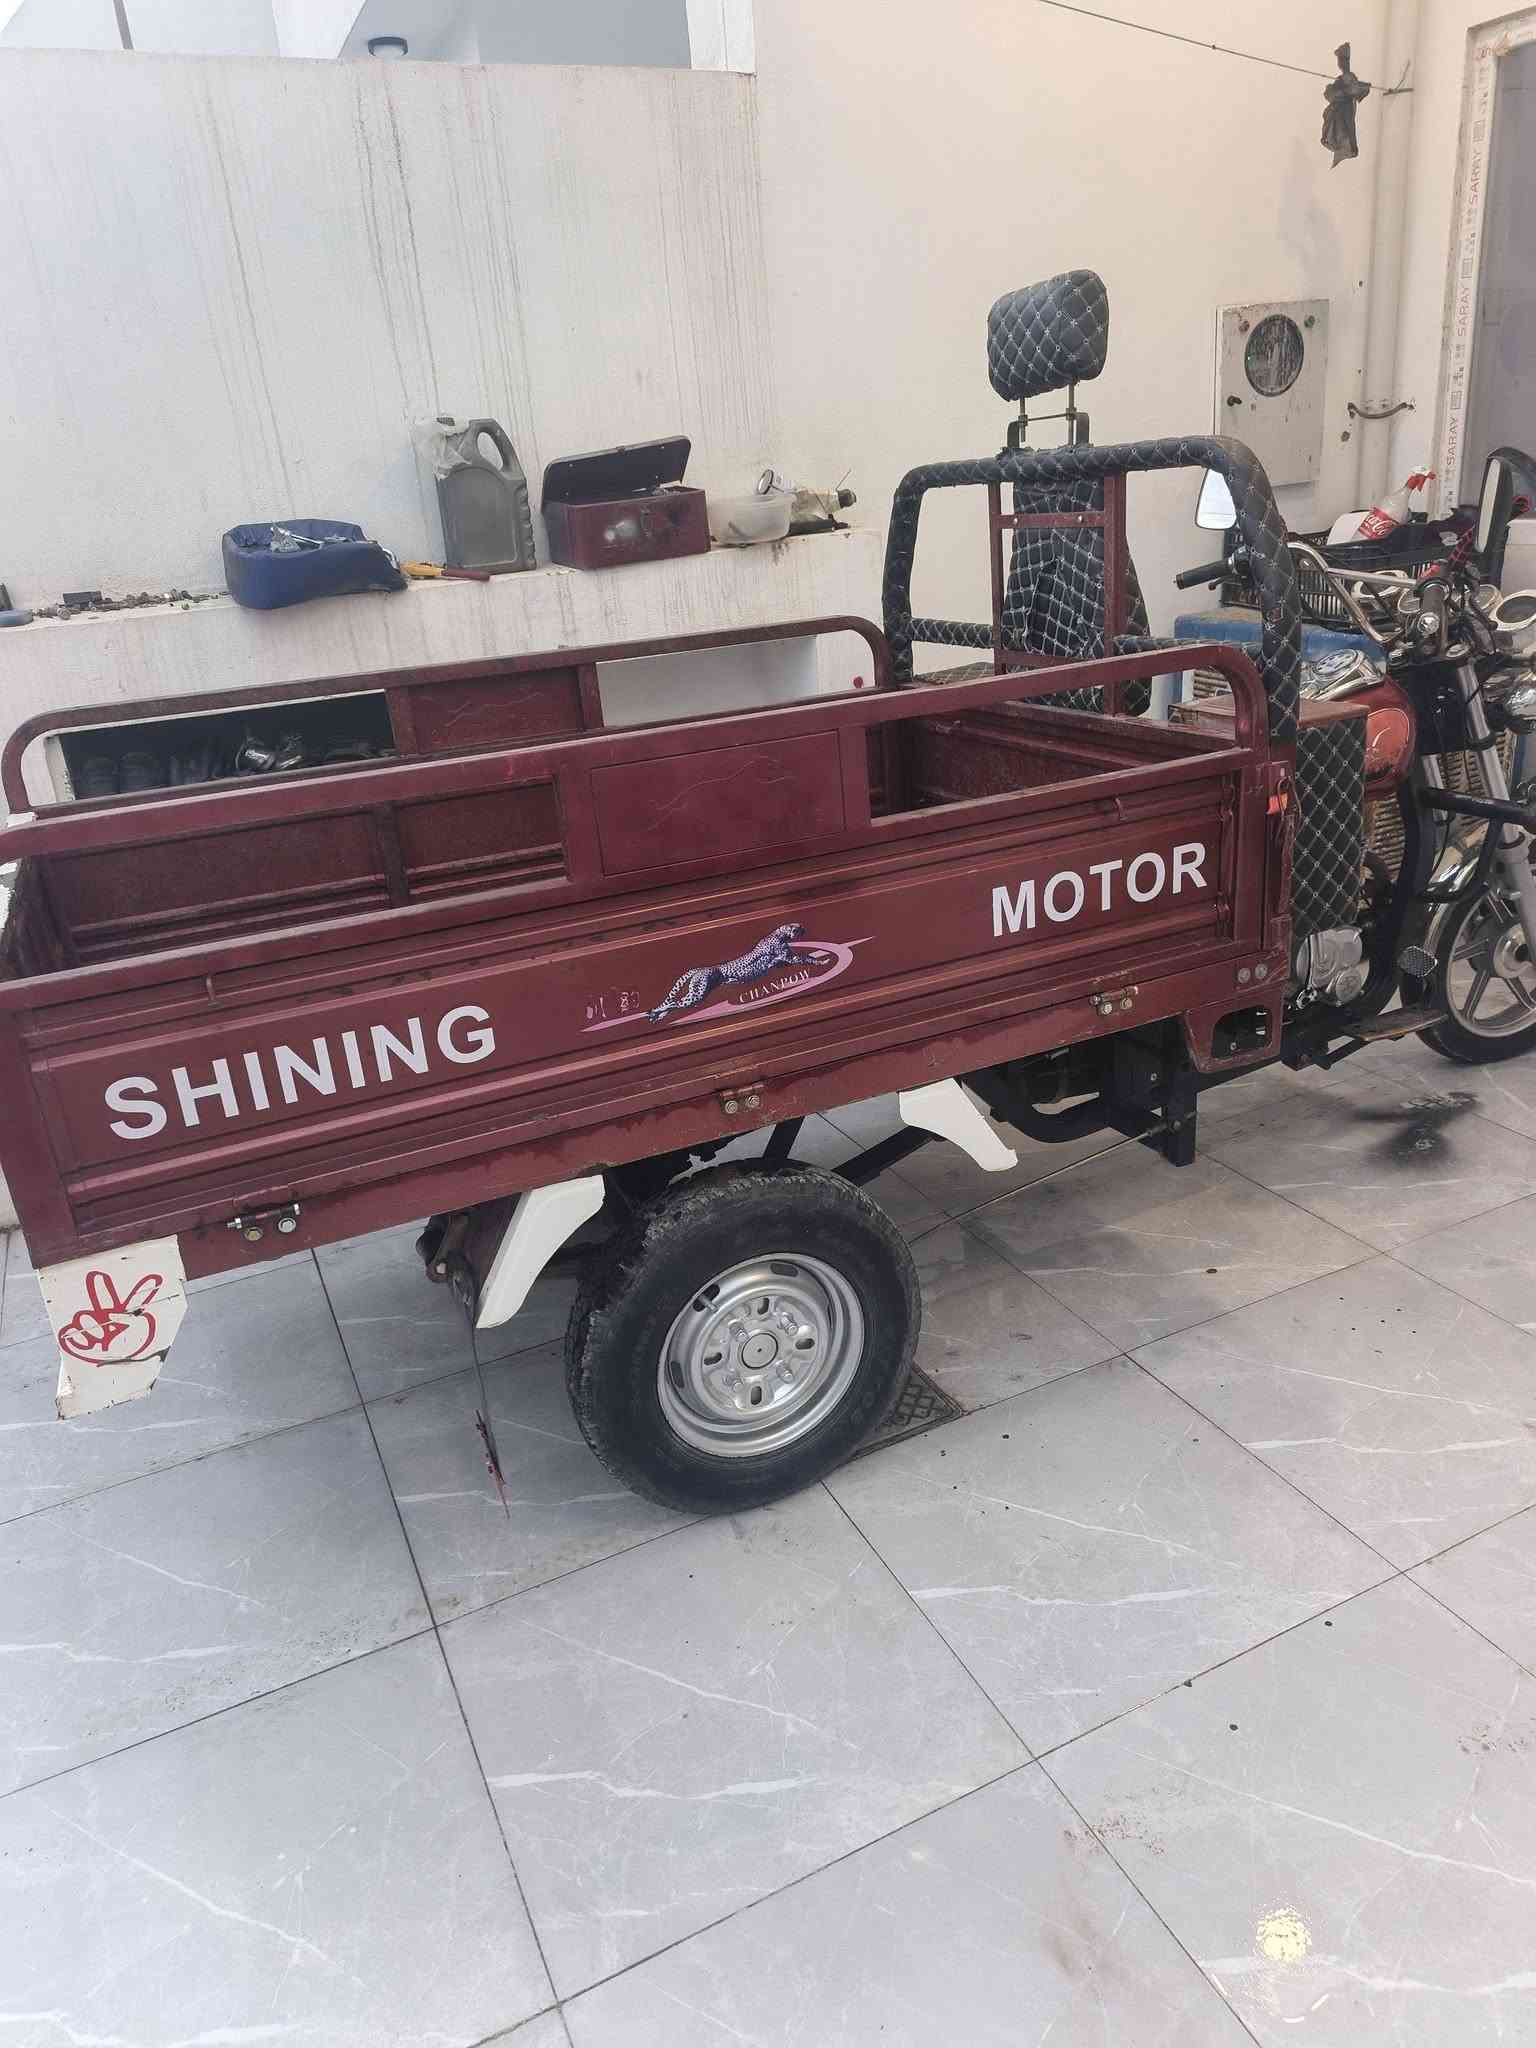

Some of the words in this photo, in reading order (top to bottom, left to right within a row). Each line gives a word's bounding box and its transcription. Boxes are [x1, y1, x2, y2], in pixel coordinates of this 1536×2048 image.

[1468, 150, 1482, 206] SARAY
[1457, 286, 1473, 337] SARAY
[1446, 416, 1458, 466] SARAY
[104, 1005, 496, 1140] SHINING
[991, 842, 1208, 937] MOTOR
